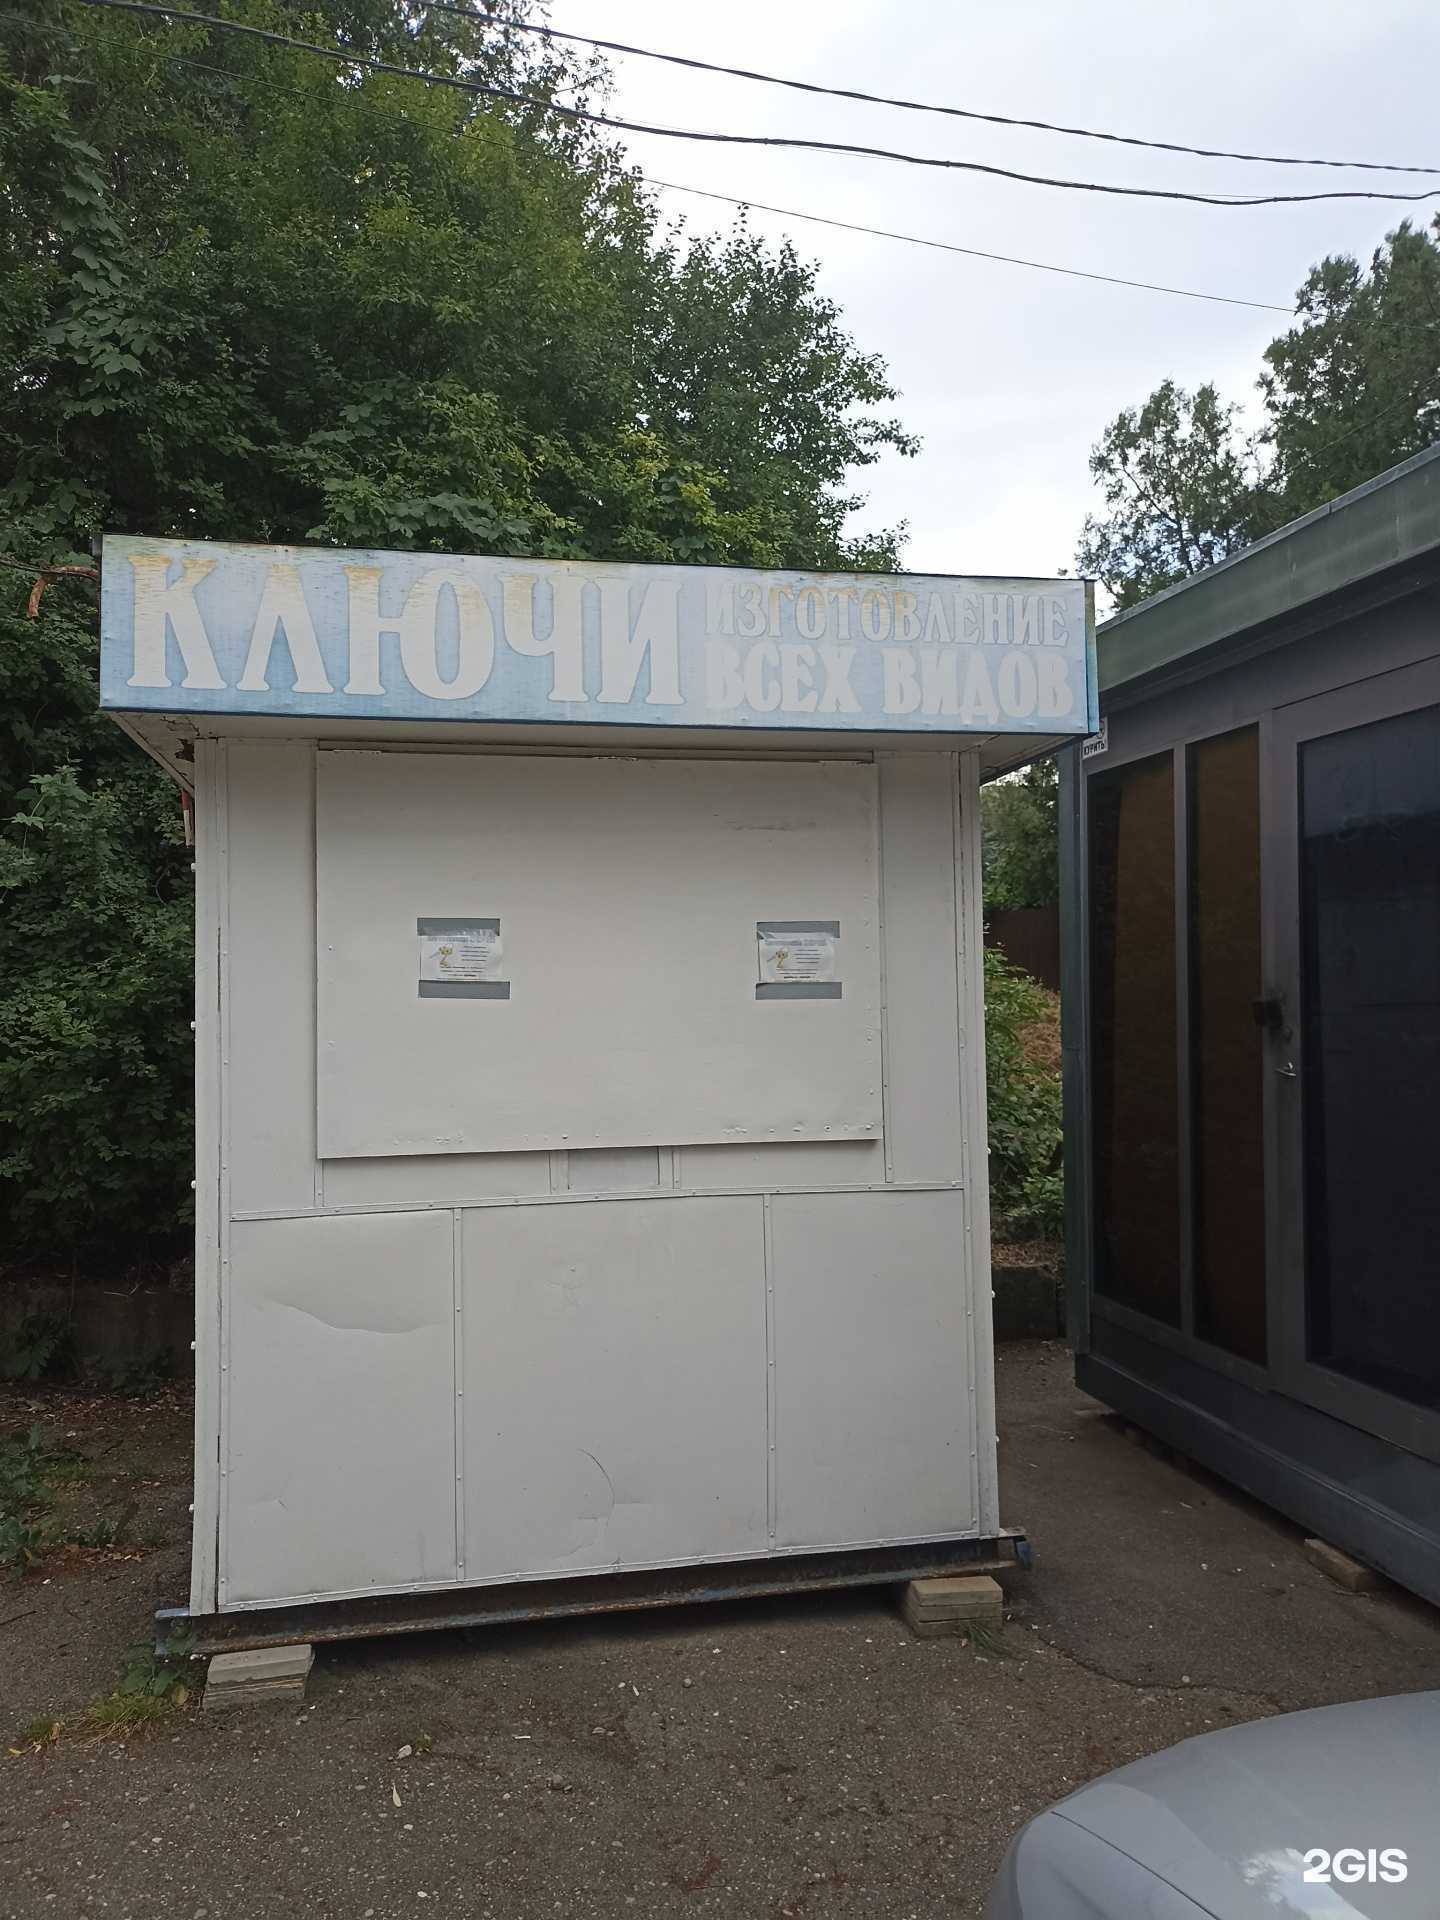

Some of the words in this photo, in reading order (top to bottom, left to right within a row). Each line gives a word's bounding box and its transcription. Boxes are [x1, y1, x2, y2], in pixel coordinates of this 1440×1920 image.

[127, 553, 687, 705] КЛЮЧИ
[704, 581, 1069, 647] ИЗГОТОВЛЕНИЕ
[704, 640, 863, 714] ВСЕХ
[880, 647, 1073, 725] ВИДОВ
